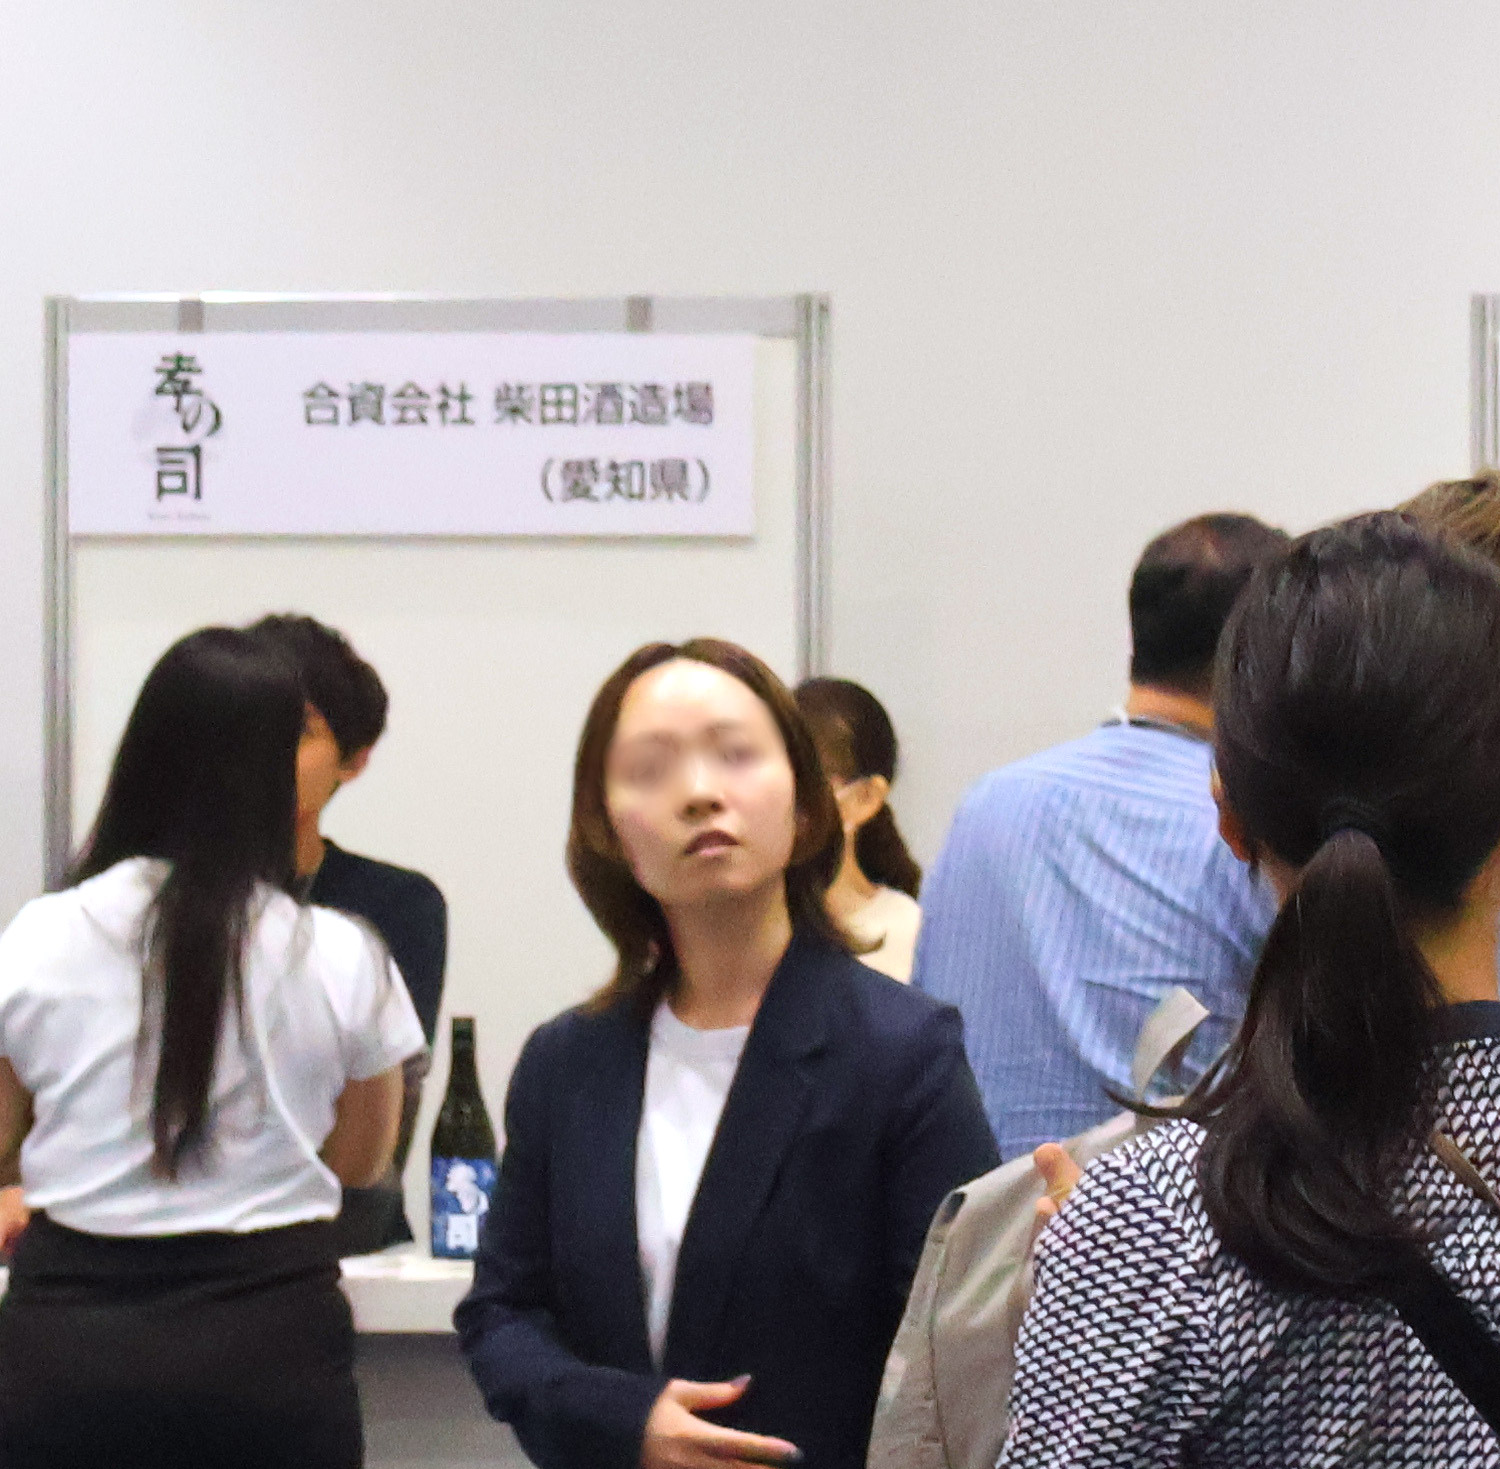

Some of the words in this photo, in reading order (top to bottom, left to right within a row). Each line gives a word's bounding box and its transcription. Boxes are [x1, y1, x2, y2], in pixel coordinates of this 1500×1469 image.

[302, 381, 475, 426] 合資会社
[493, 381, 714, 426] 柴田酒造場
